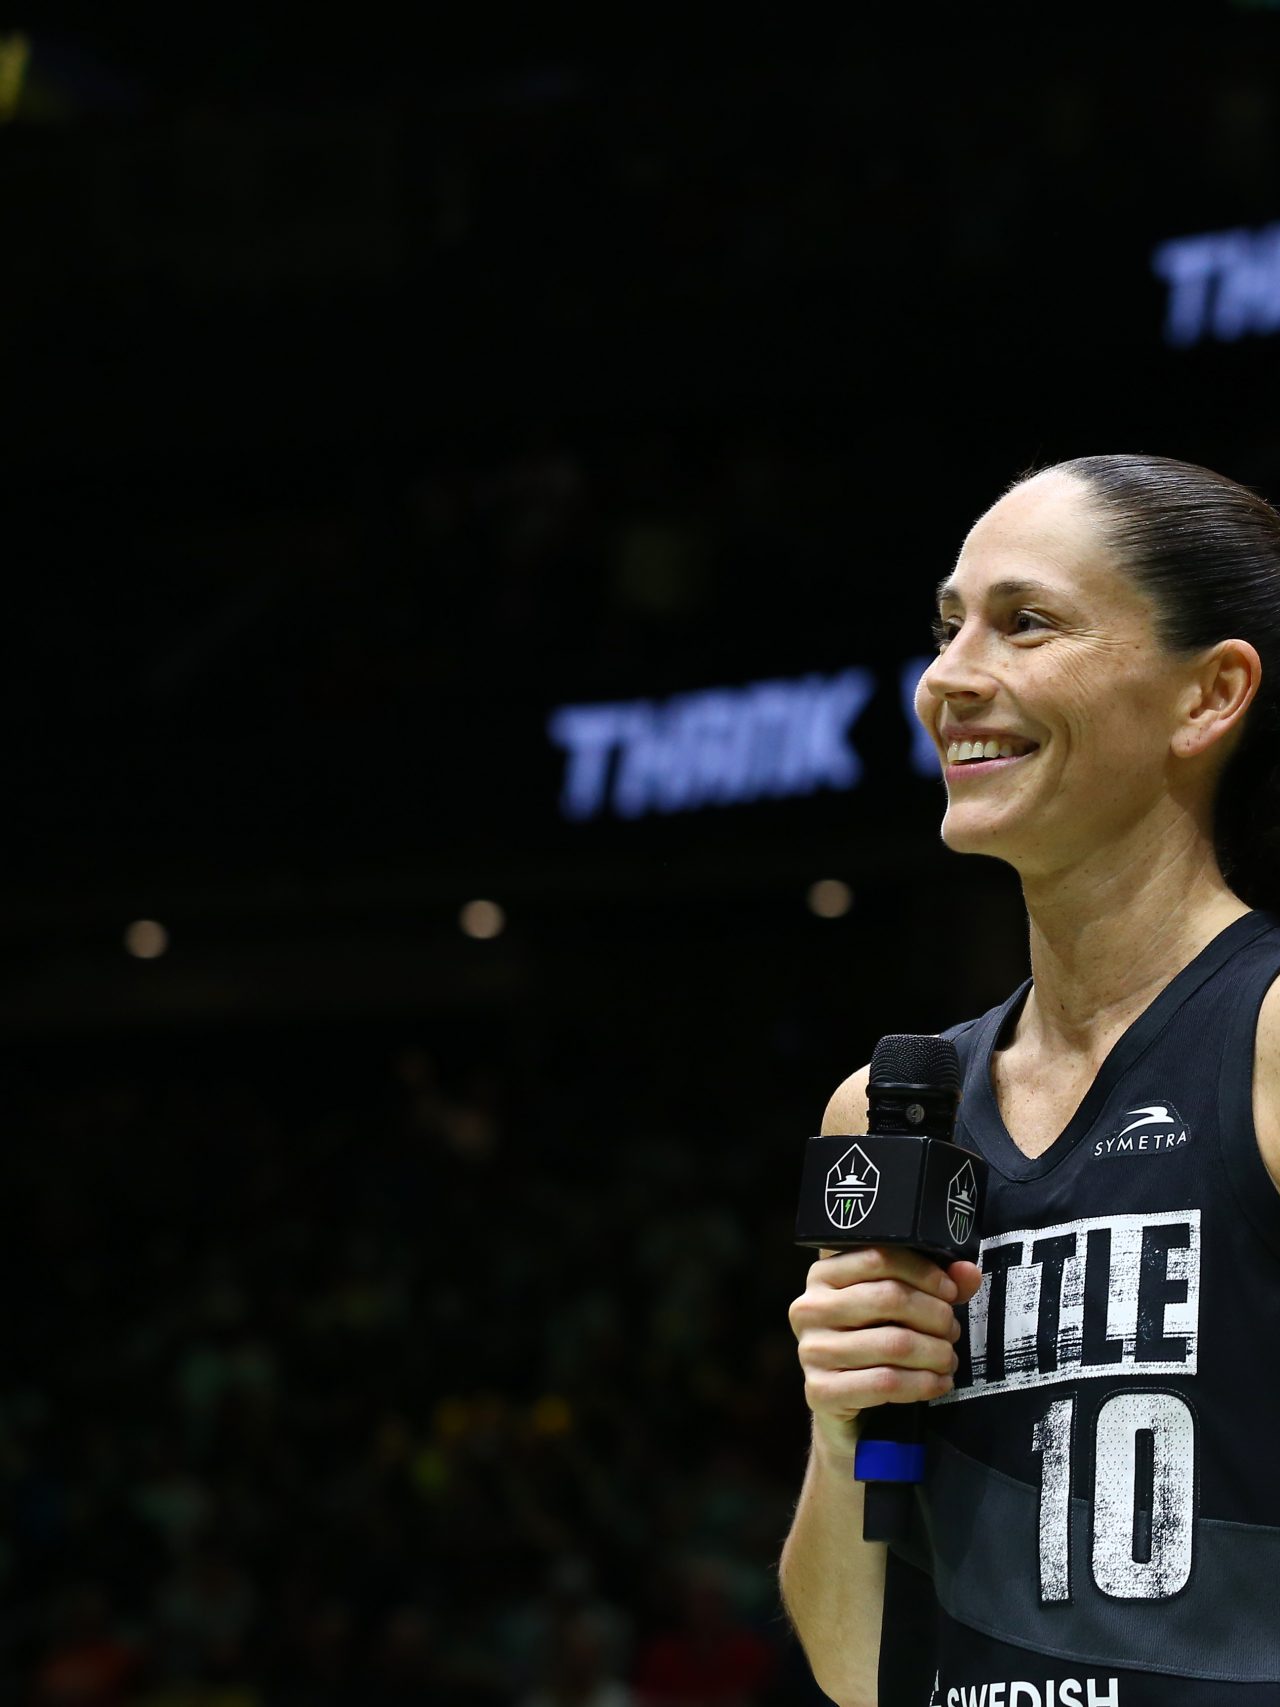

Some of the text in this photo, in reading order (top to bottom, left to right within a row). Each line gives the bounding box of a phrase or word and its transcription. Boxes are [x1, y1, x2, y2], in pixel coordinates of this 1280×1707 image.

[551, 668, 872, 819] THANK
[1094, 1130, 1187, 1156] SYMETRA
[1032, 1393, 1195, 1601] 10
[947, 1677, 1119, 1707] SWEDISH
